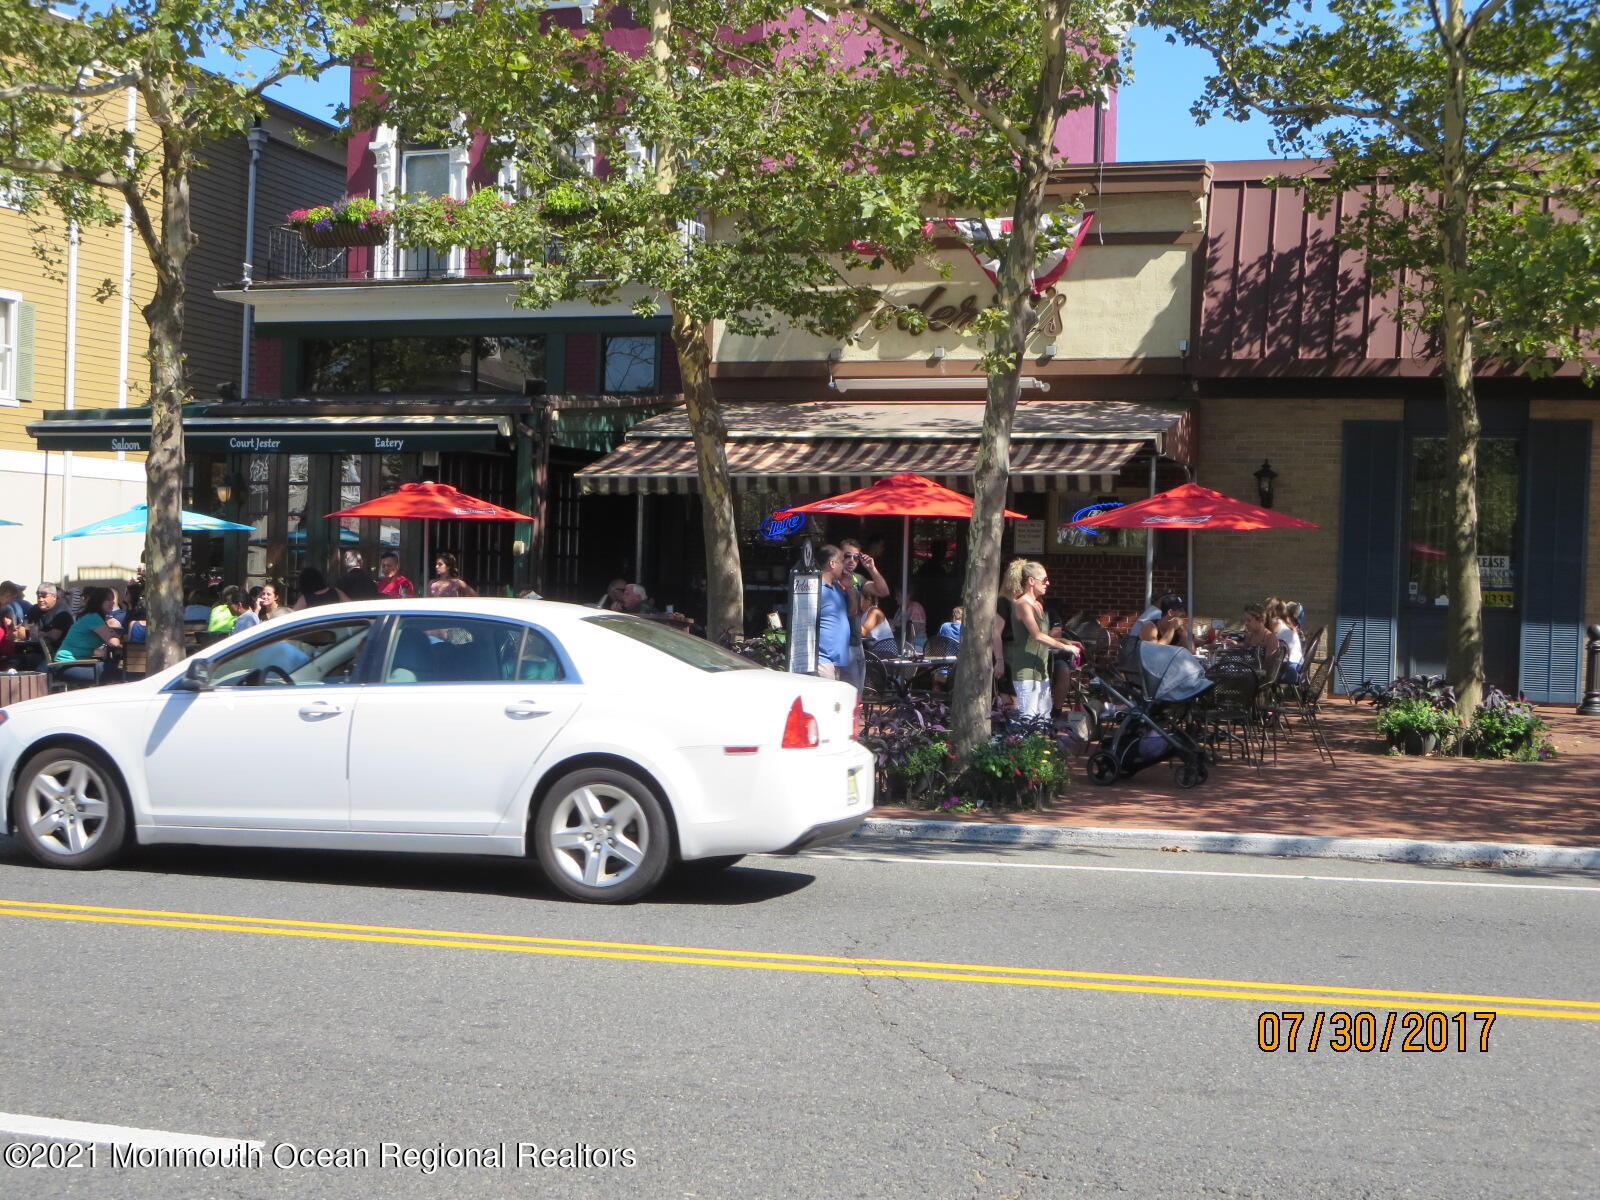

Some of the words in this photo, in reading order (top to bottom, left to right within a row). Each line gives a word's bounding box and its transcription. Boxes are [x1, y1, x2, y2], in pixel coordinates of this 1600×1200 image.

[112, 438, 141, 450] Saloon
[230, 438, 254, 448] Court
[255, 438, 280, 450] Jester
[374, 437, 403, 450] Eatery
